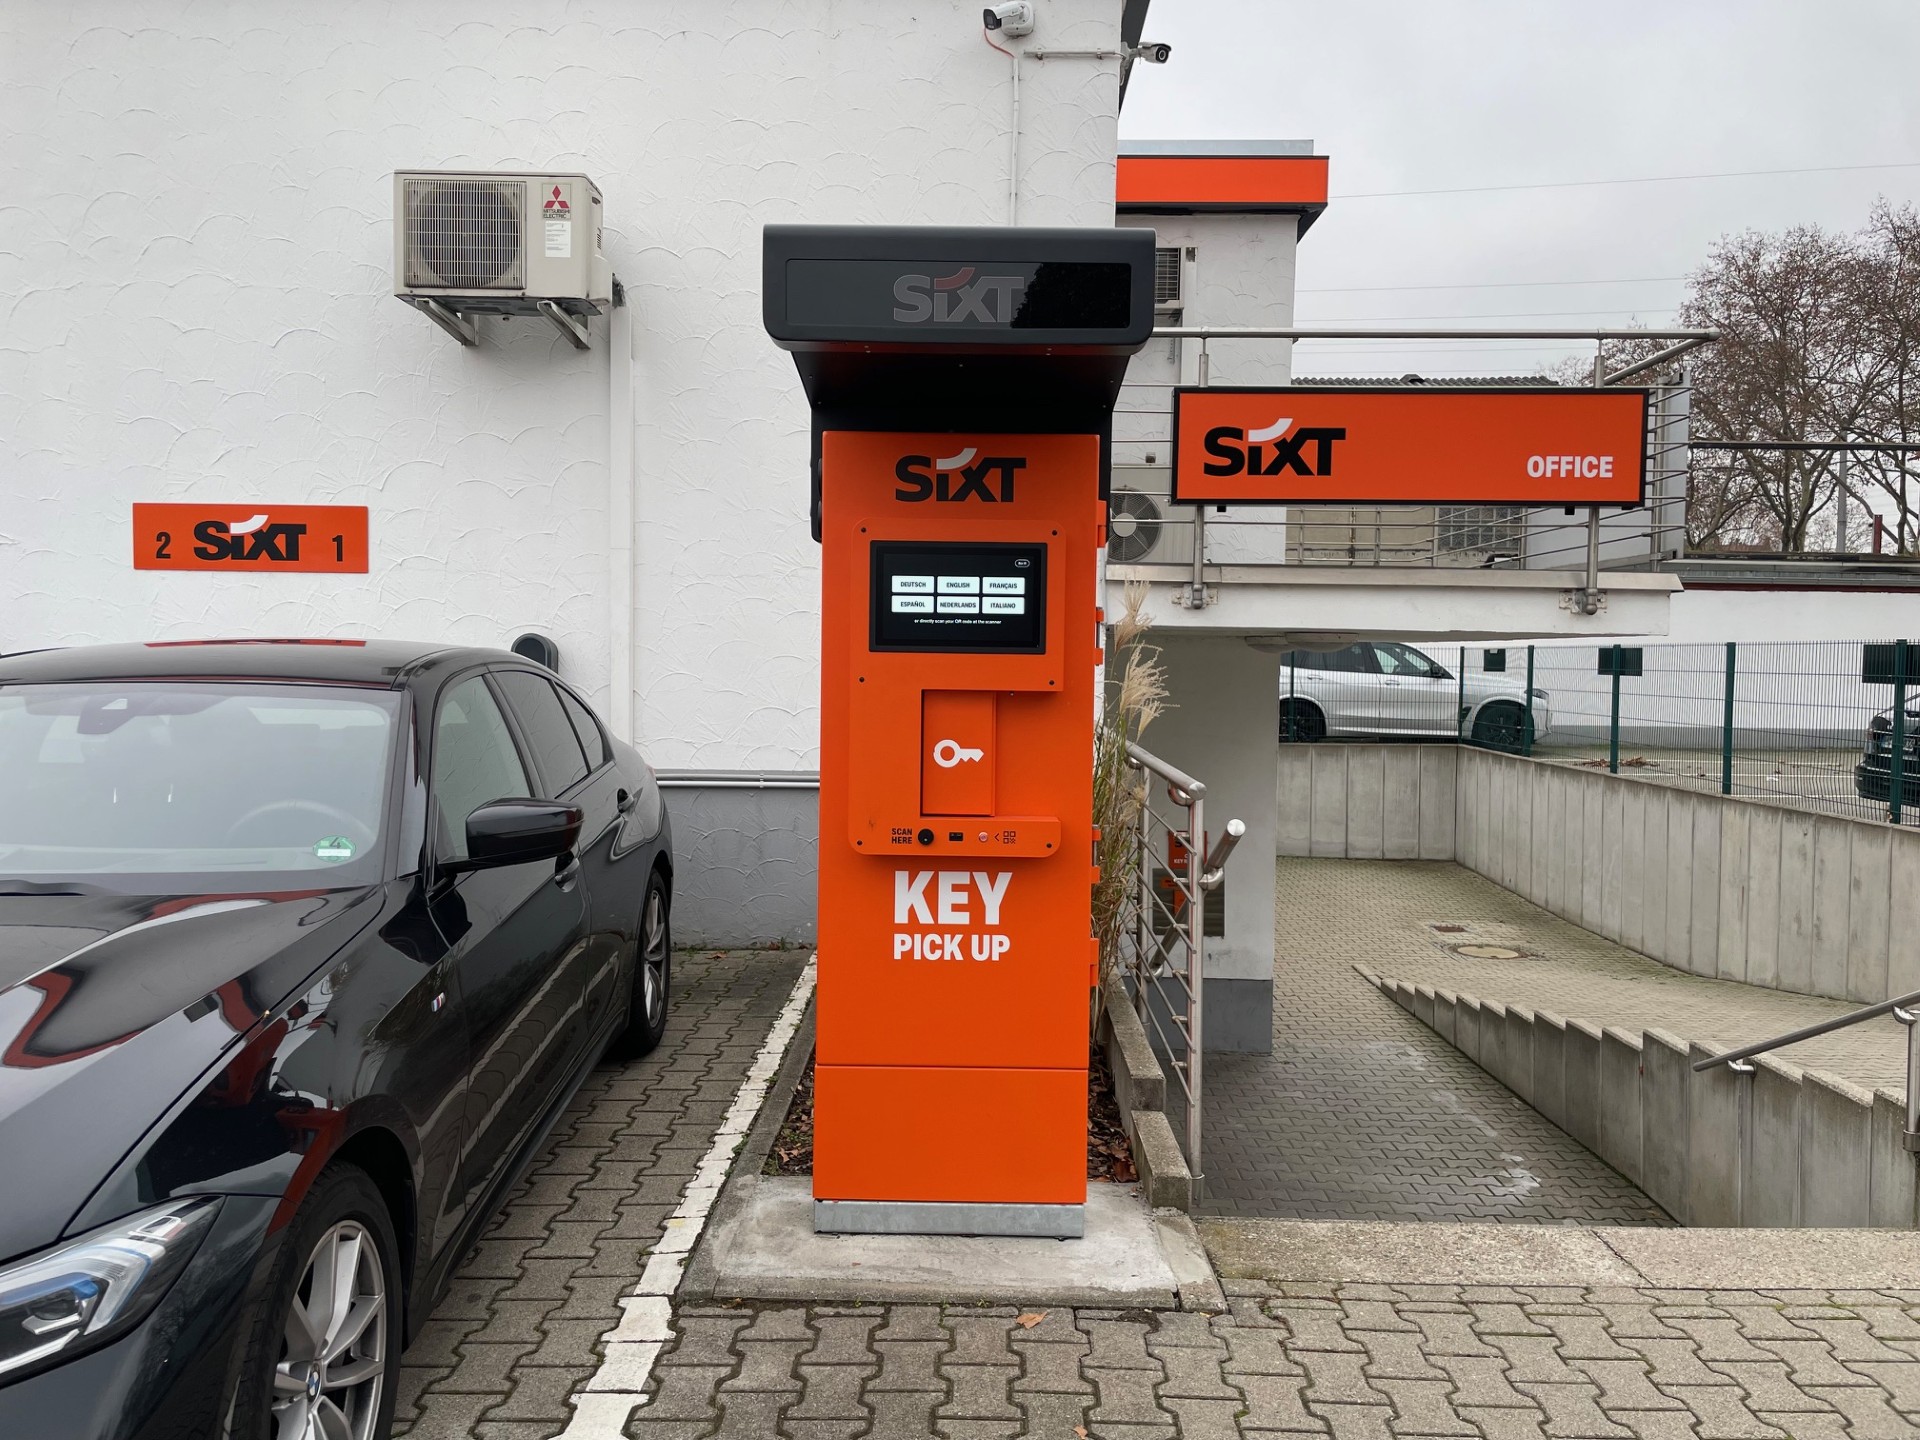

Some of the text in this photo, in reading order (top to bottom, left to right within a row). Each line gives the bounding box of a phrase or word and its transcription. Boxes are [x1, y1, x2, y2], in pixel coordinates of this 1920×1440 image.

[1526, 454, 1615, 479] OFFICE
[155, 531, 171, 560] 2
[332, 534, 344, 562] 1
[330, 837, 342, 848] 4
[891, 827, 913, 836] SCAN
[891, 837, 913, 845] HERE
[894, 870, 1013, 925] KEY
[893, 933, 1011, 961] PICK UP
